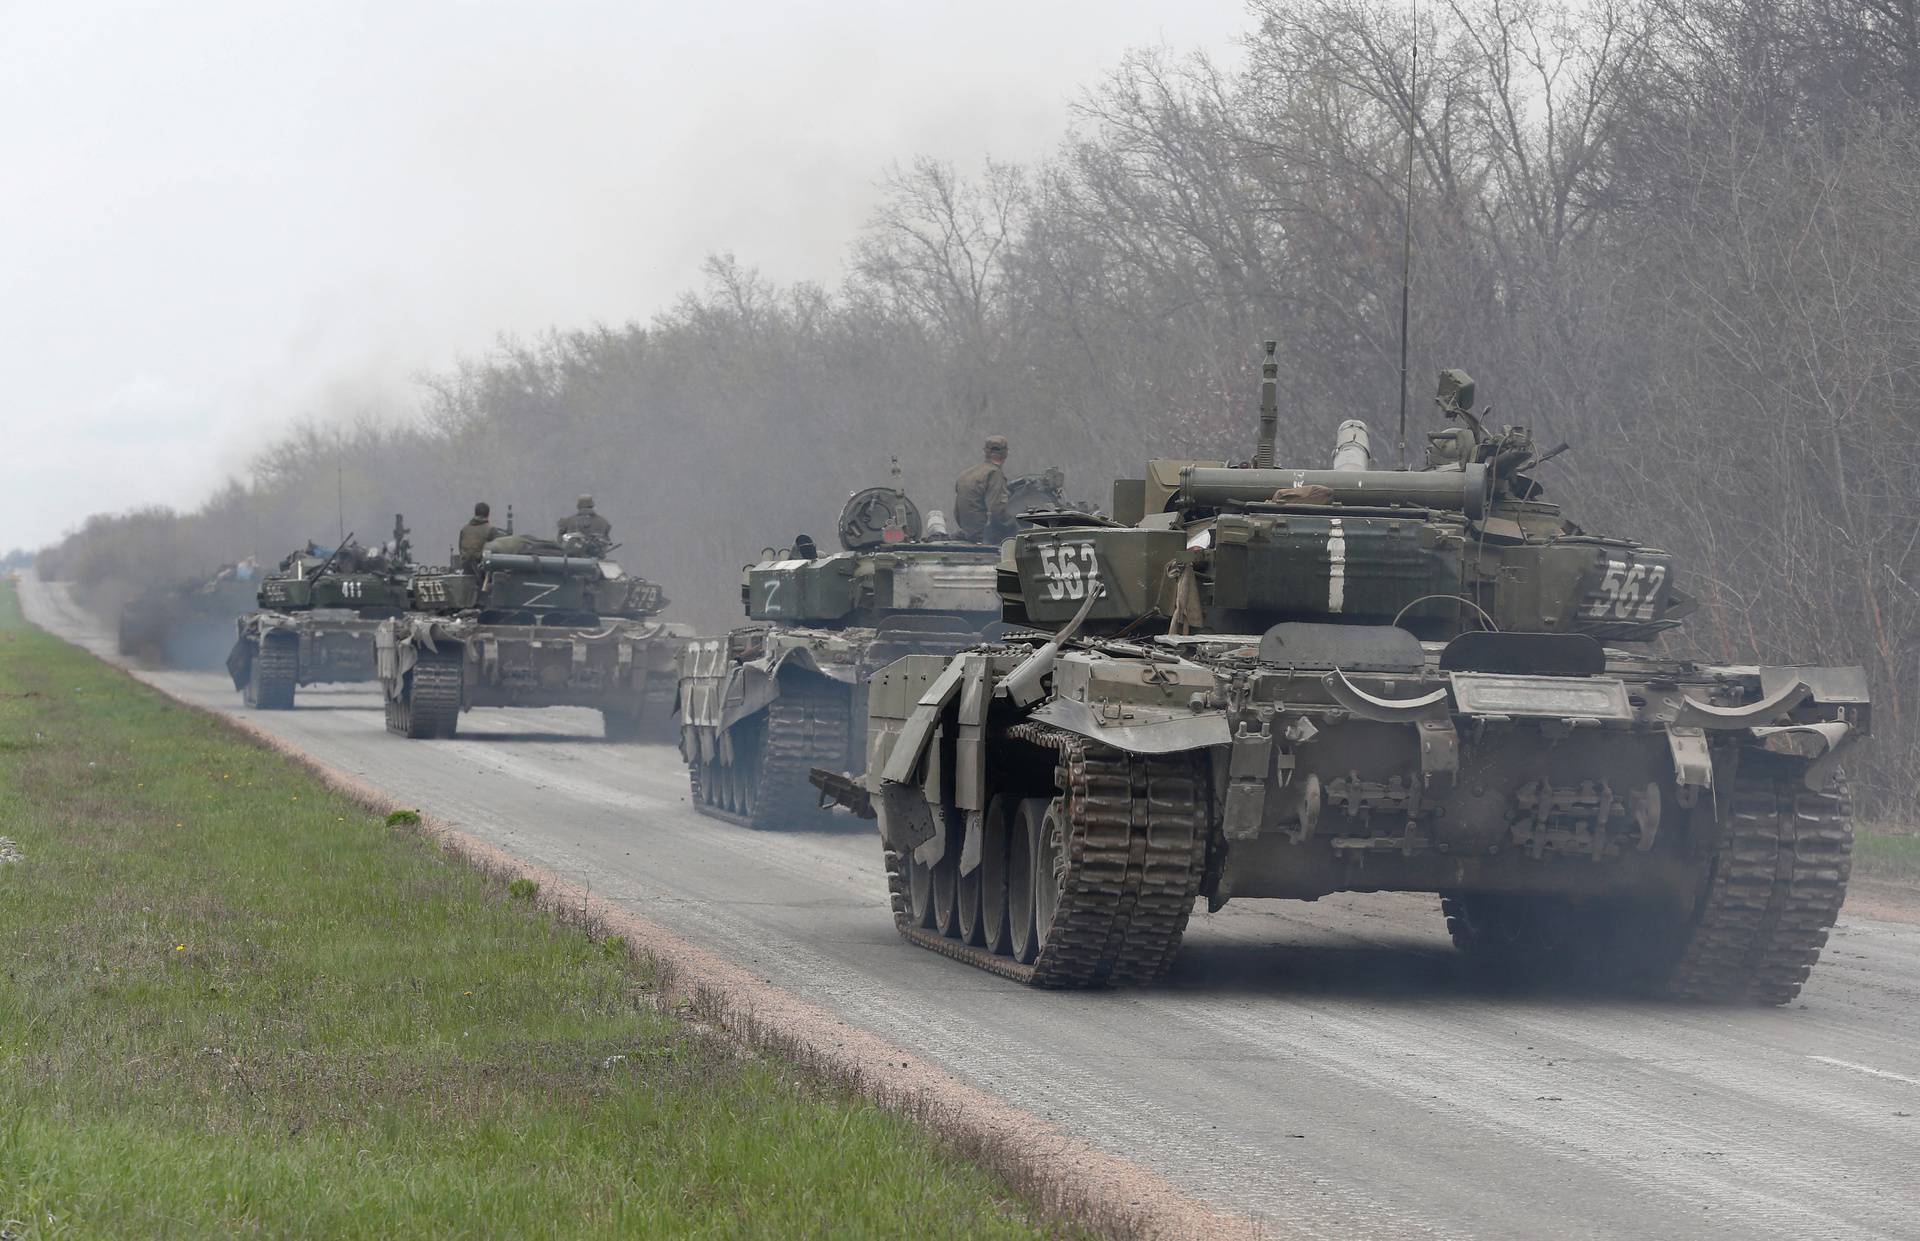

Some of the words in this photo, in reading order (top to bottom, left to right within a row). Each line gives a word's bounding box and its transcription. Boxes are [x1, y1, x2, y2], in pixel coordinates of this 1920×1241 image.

[523, 582, 560, 607] Z
[1038, 543, 1107, 600] 562
[1588, 560, 1666, 619] 562
